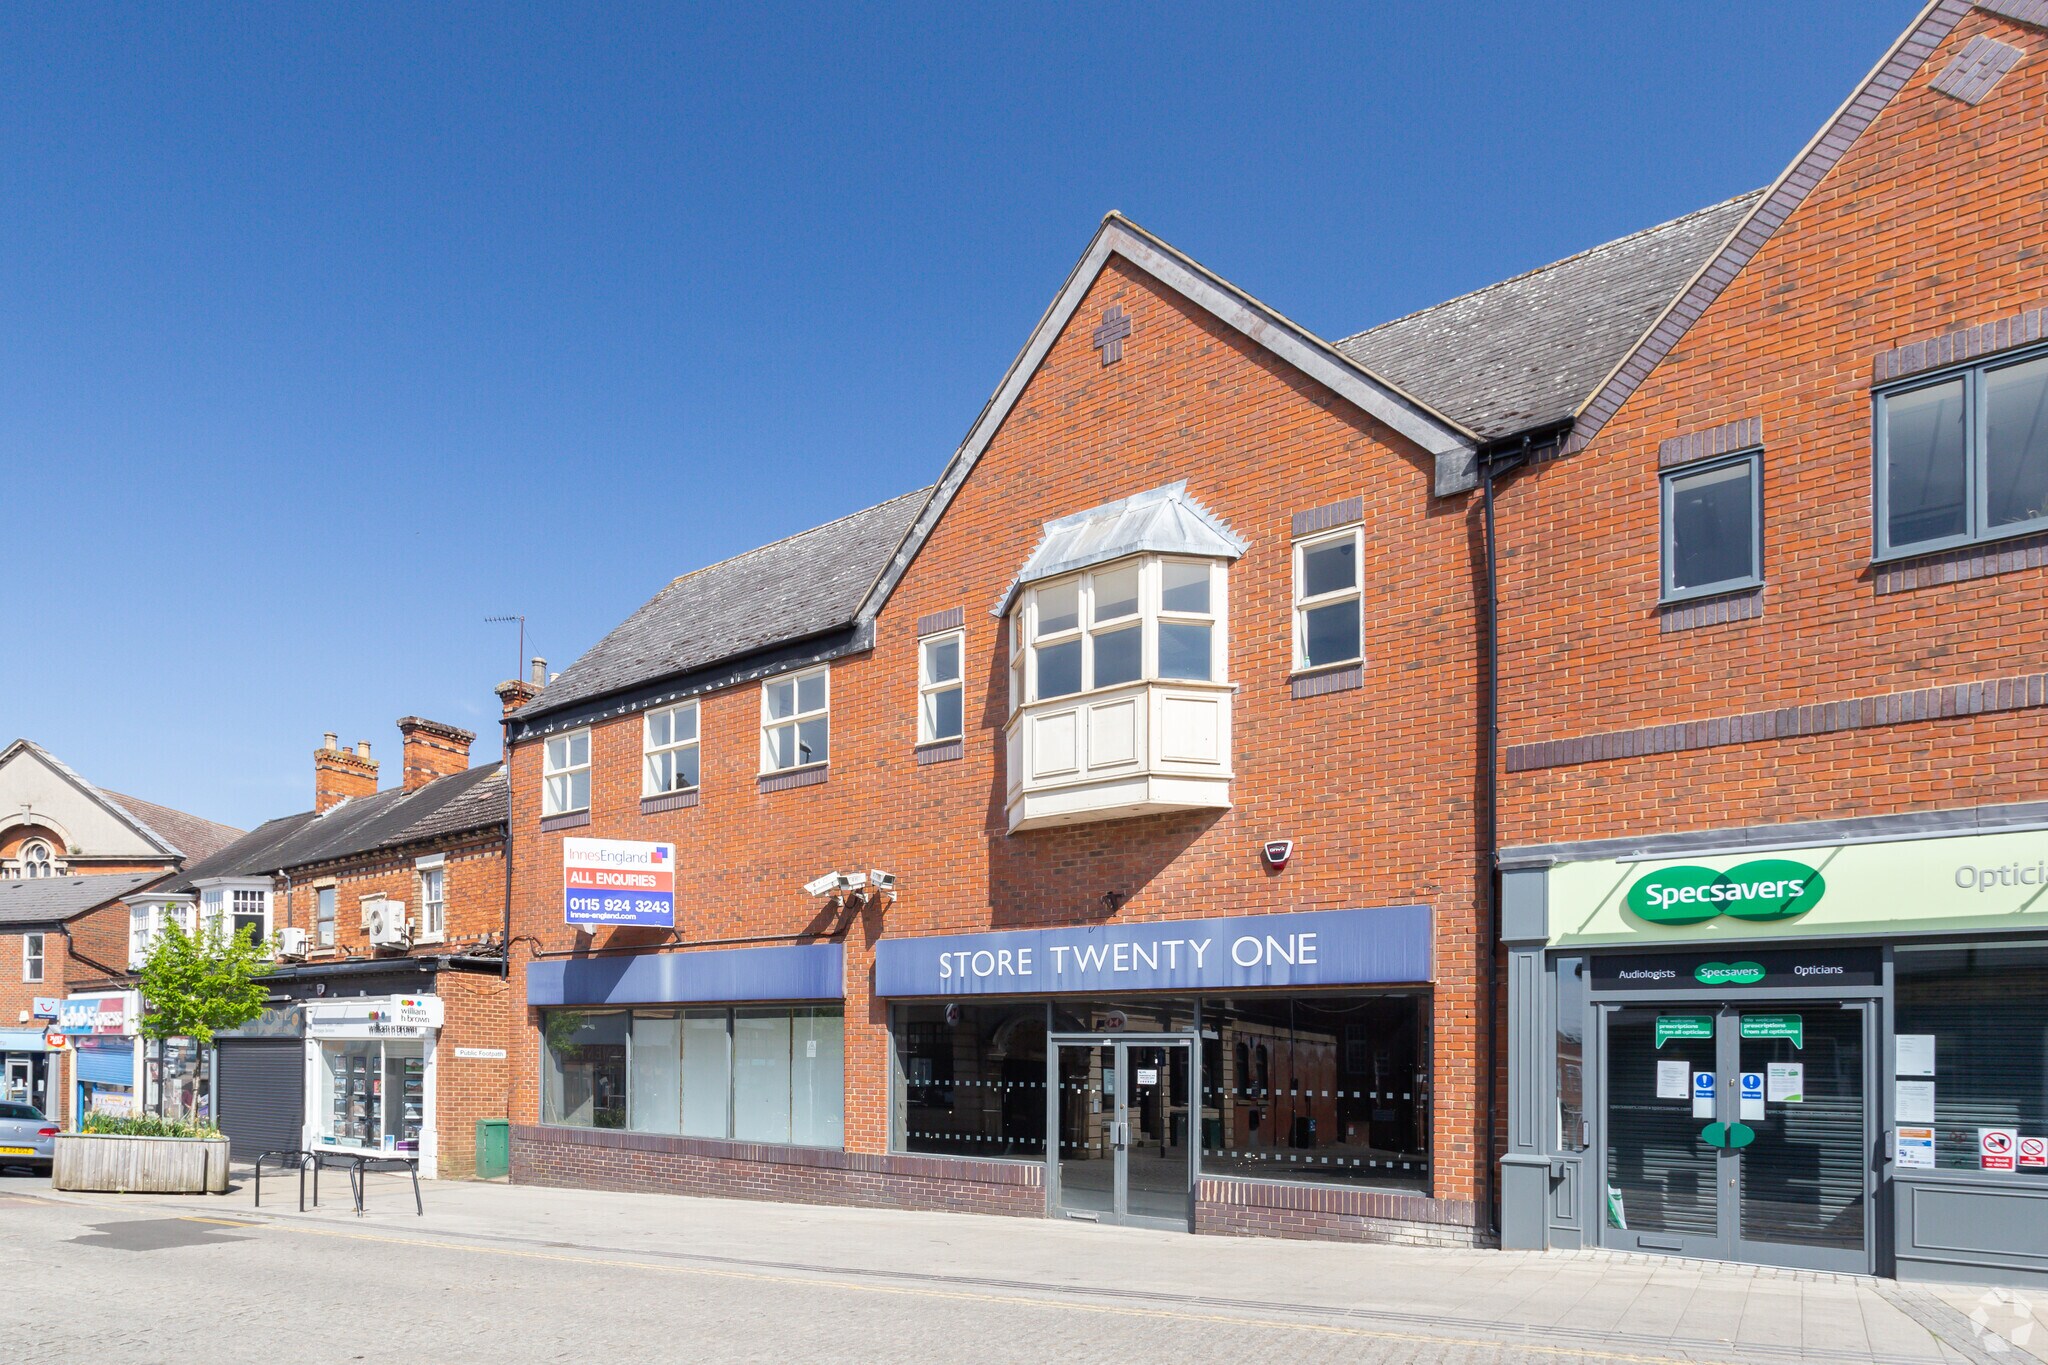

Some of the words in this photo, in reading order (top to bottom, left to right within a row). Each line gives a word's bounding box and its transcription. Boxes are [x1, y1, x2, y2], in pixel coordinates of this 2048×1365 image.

[570, 871, 593, 884] ALL
[596, 873, 656, 887] ENQUIRIES
[1955, 860, 2048, 892] Optici
[1646, 879, 1804, 909] Specsavers
[570, 897, 600, 911] 0115
[604, 899, 630, 911] 924
[635, 901, 670, 914] 3243
[939, 948, 1033, 979] STORE
[1050, 938, 1212, 974] TWENTY
[1231, 932, 1318, 967] ONE
[1619, 969, 1676, 979] Audiologists
[1701, 967, 1759, 978] Specsavers
[1794, 965, 1844, 976] Opticians
[401, 1008, 427, 1016] william
[407, 1015, 430, 1023] brown
